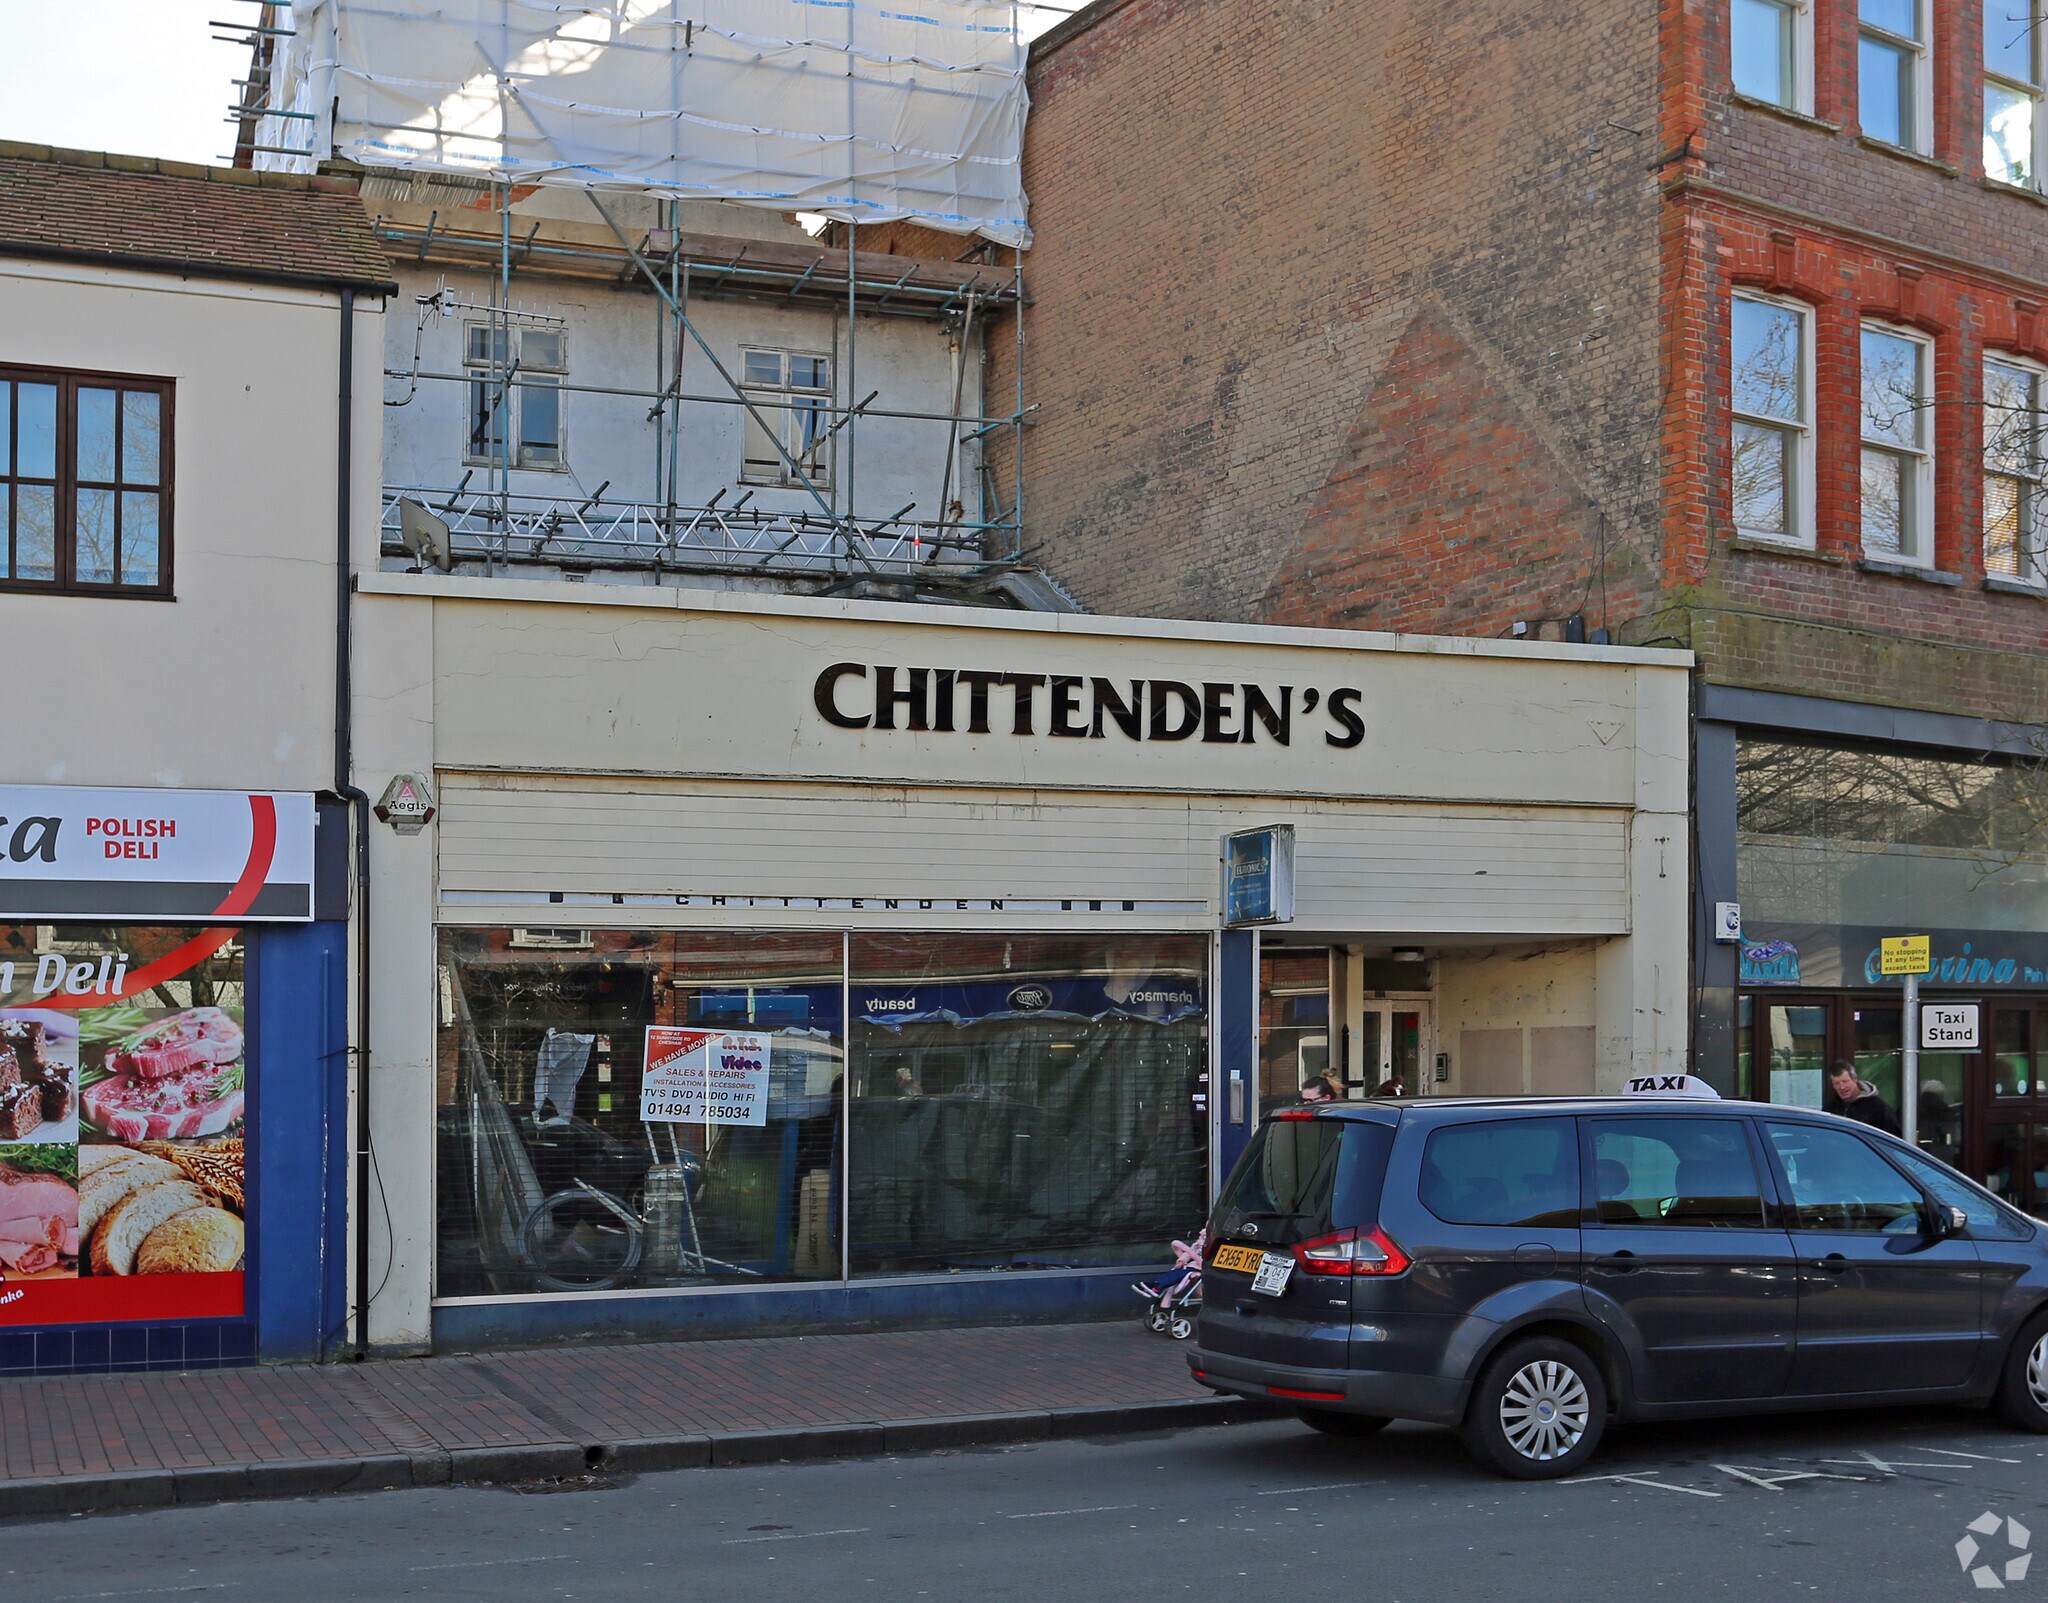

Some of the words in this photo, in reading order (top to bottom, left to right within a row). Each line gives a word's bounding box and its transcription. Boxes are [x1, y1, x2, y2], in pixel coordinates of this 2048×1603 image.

[813, 662, 1366, 748] CHITTENDEN'S
[389, 801, 427, 812] Aegis
[86, 817, 177, 838] POLISH
[104, 840, 159, 859] DELI
[1896, 948, 1927, 957] stopping
[33, 953, 129, 995] Deli
[1885, 964, 1908, 972] except
[1935, 1011, 1965, 1024] Taxi
[1928, 1027, 1973, 1041] Stand
[649, 1058, 663, 1070] WE
[664, 1047, 688, 1063] HAVE
[687, 1032, 717, 1052] MOVED
[720, 1054, 763, 1072] Video
[665, 1067, 696, 1077] SALES
[698, 1069, 705, 1077] &
[707, 1070, 746, 1079] REPAIRS
[653, 1079, 703, 1087] INSTALLATION
[709, 1081, 756, 1089] ACCESSORIES
[1629, 1075, 1686, 1092] TAXI
[644, 1088, 667, 1097] TV'S
[671, 1090, 694, 1099] DVD
[696, 1091, 728, 1101] AUDIO
[647, 1102, 691, 1116] 01494
[699, 1104, 751, 1119] 785034
[1216, 1247, 1244, 1267] EX56
[1271, 1267, 1287, 1279] 043
